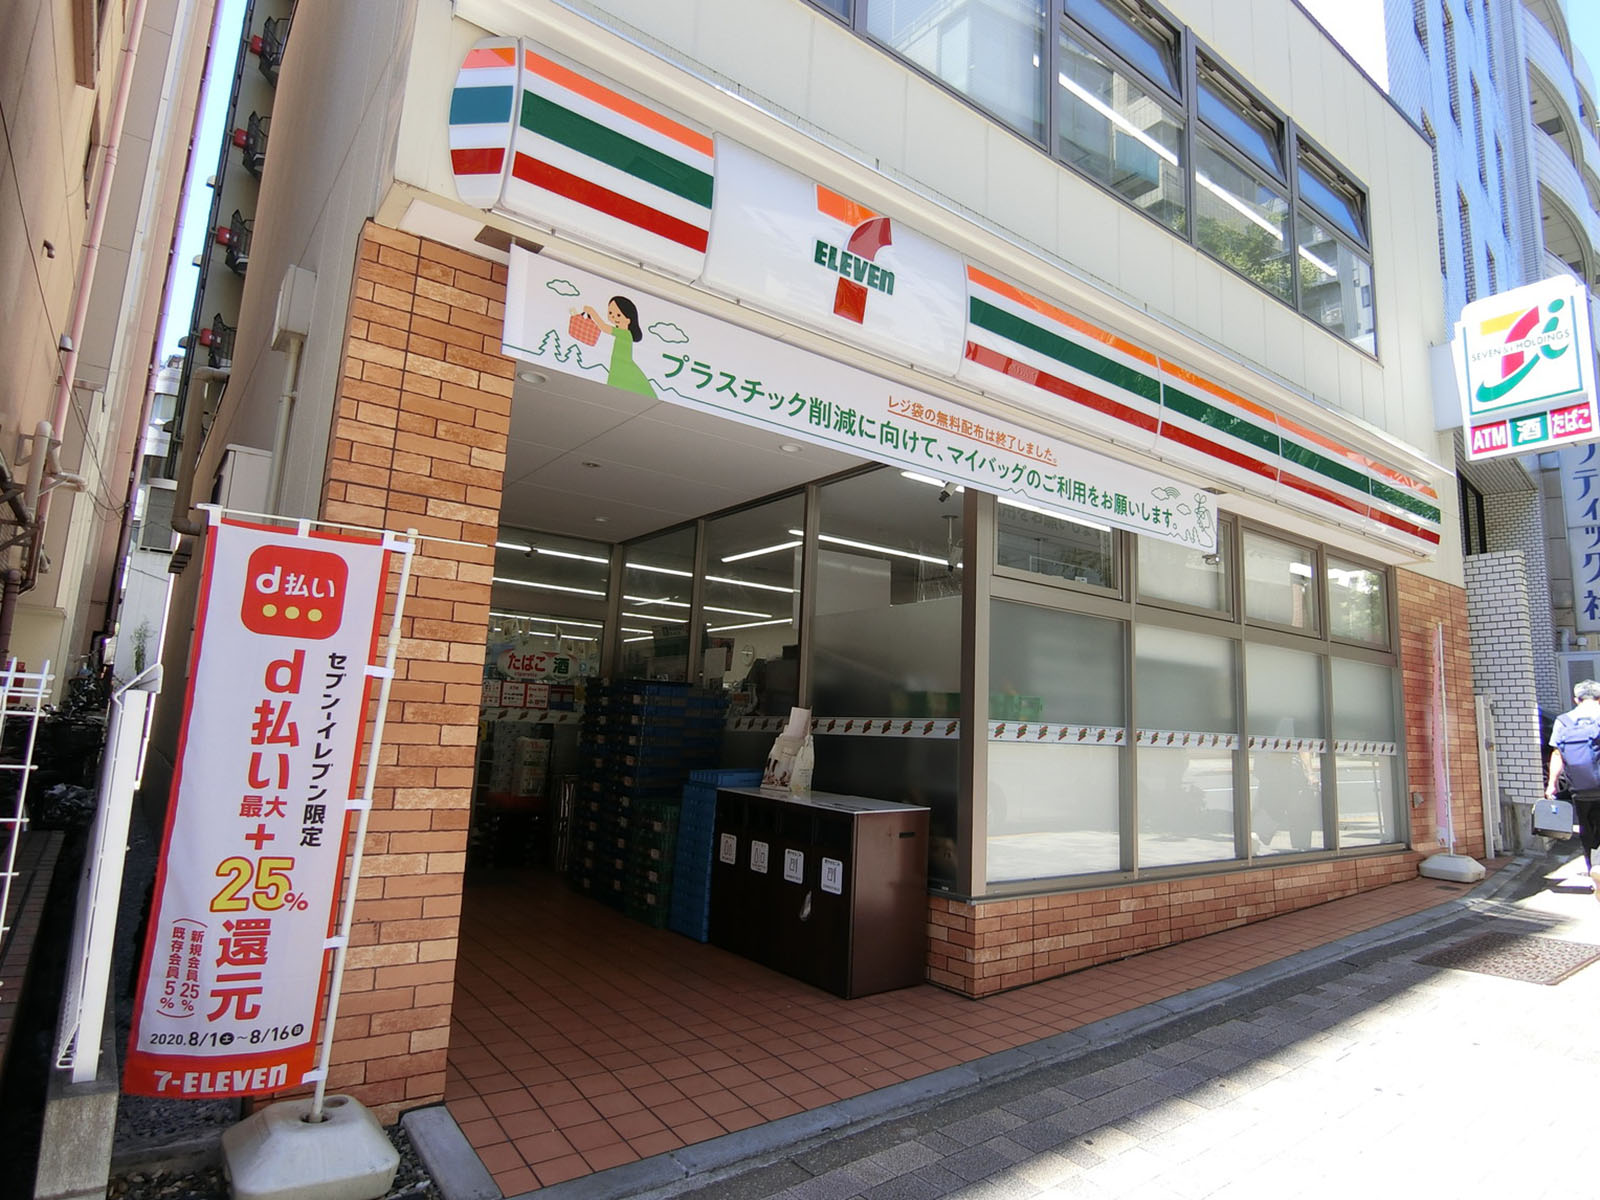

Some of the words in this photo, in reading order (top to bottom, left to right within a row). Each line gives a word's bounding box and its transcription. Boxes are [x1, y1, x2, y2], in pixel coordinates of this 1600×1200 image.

[814, 239, 896, 296] ELEVEN
[1516, 328, 1570, 350] HOLDINGS
[888, 395, 1058, 464] レジ袋の無料配布は終了しました。
[1516, 417, 1543, 443] 酒
[1551, 407, 1592, 436] たばこ
[1473, 426, 1506, 451] ATM
[255, 565, 335, 598] d払い
[507, 653, 546, 672] たばこ
[552, 657, 570, 674] 酒
[247, 649, 306, 790] d払い
[239, 795, 288, 819] 最大
[207, 918, 272, 1022] 還元
[154, 1063, 288, 1094] 7-ELEVEN
